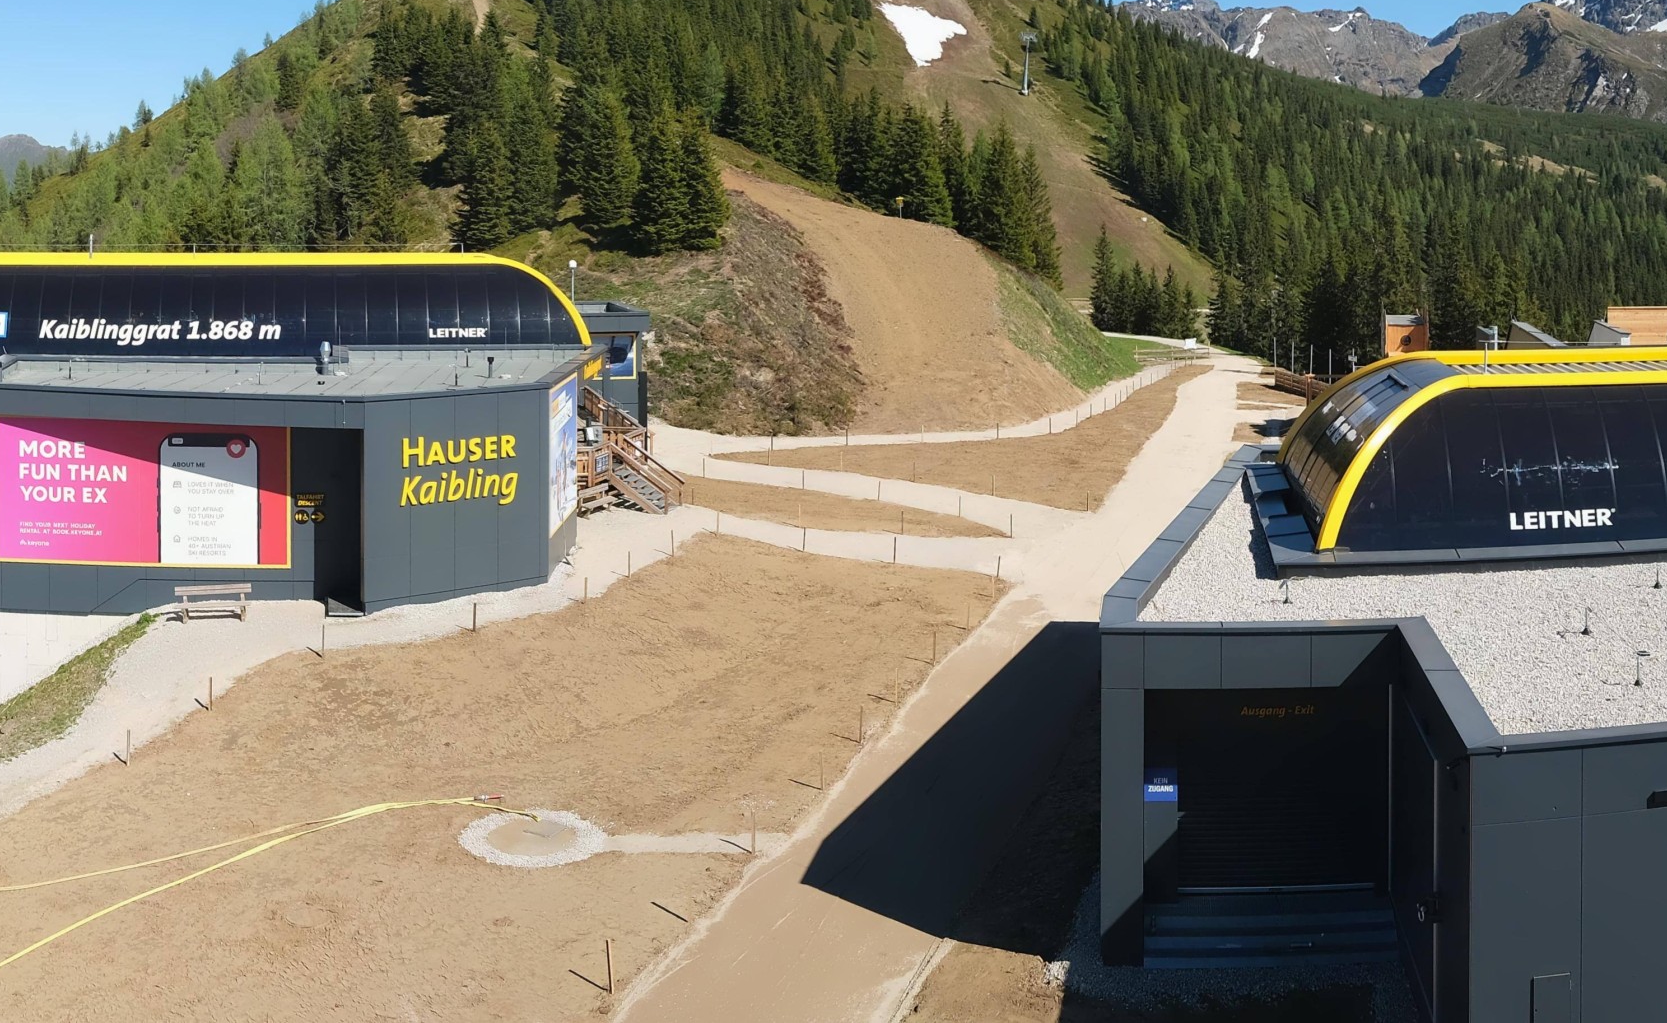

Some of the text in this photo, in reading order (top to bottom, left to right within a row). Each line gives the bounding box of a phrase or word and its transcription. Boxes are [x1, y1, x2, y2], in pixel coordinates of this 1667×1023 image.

[39, 318, 282, 346] Kaiblinggrat 1.868 m
[429, 328, 488, 338] LEITNER
[18, 440, 86, 459] MORE
[402, 434, 516, 468] HAUSER
[19, 463, 127, 482] FUN THAN
[20, 485, 108, 504] YOUR EX
[400, 468, 519, 507] Kaibling
[1510, 508, 1616, 530] LEITNER
[1241, 705, 1285, 718] Ausgang
[1294, 705, 1315, 715] Exit
